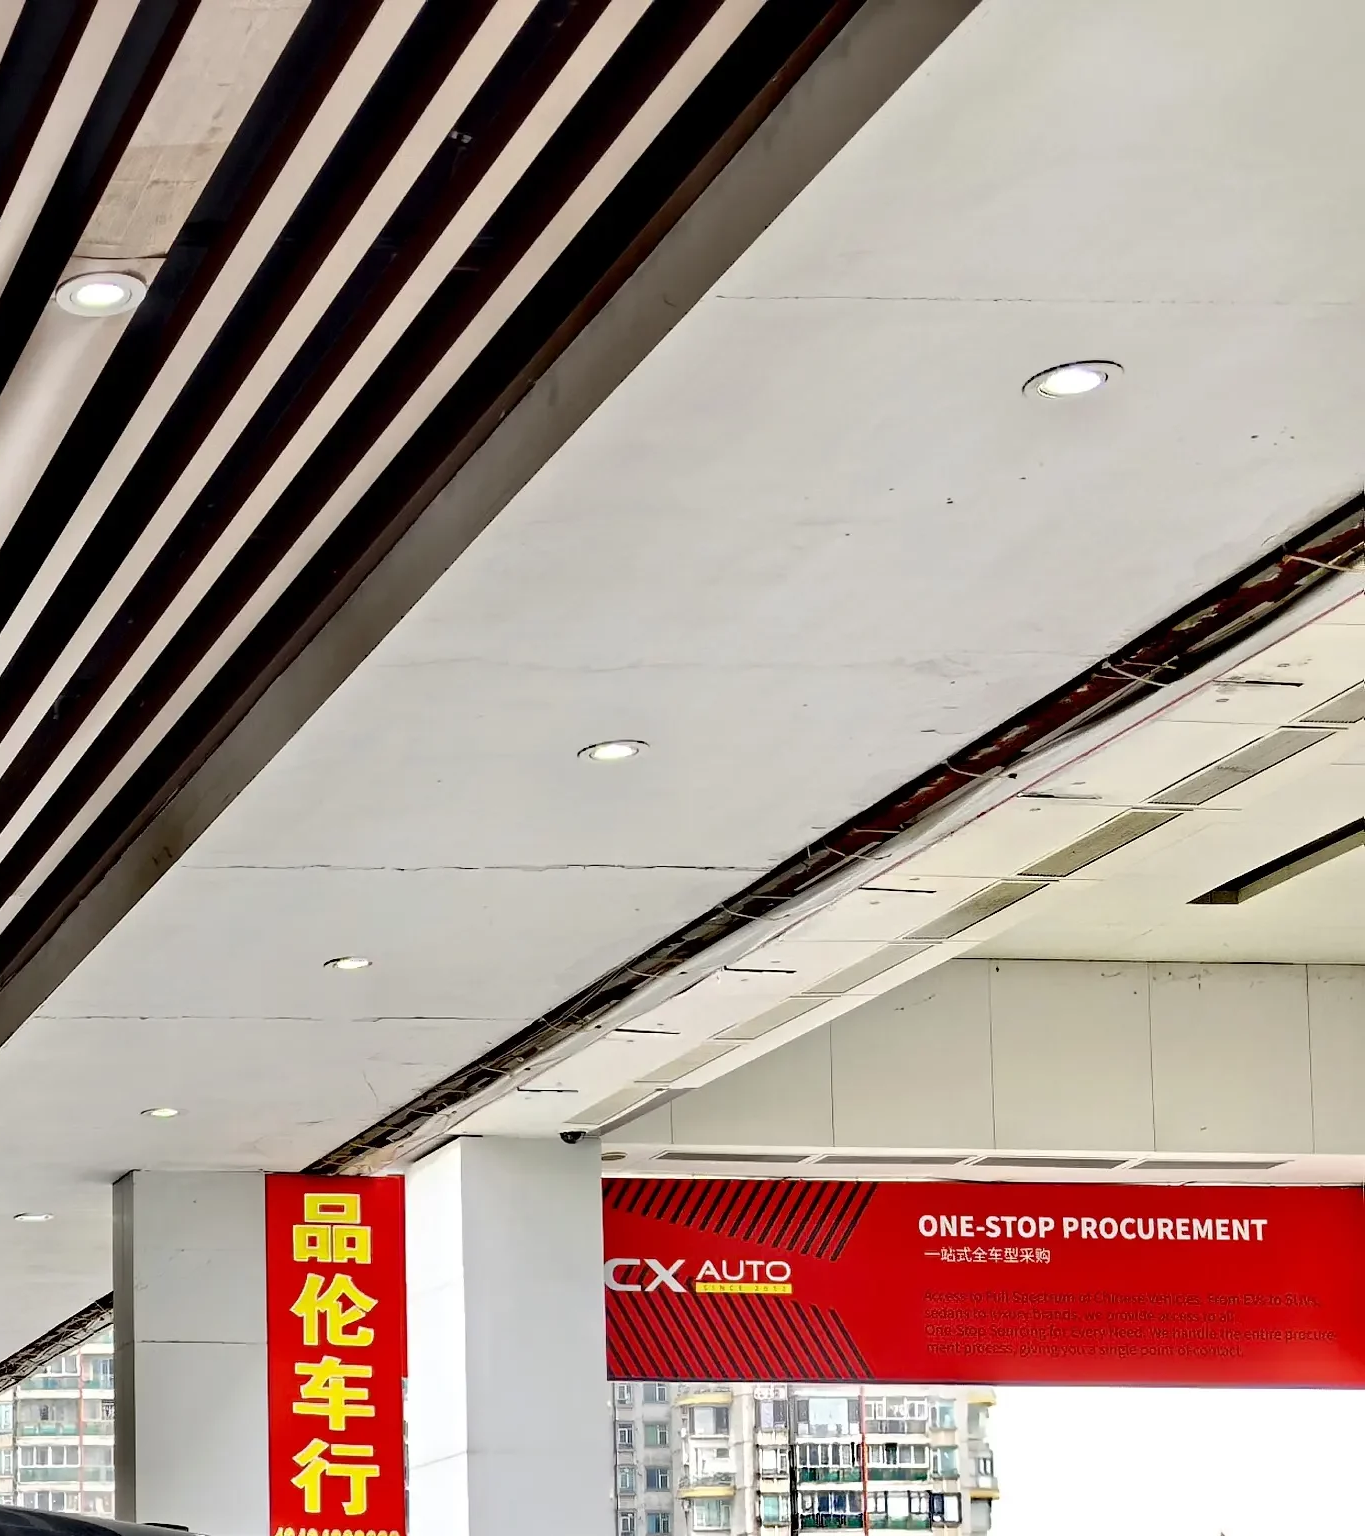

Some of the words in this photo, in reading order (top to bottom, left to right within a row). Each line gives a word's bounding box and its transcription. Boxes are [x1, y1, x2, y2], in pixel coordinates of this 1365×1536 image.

[918, 1214, 1055, 1239] ONE-STOP
[1062, 1216, 1269, 1241] PROCUREMENT
[924, 1246, 1051, 1264] 一站式全车型采购
[604, 1257, 687, 1293] CX
[695, 1259, 792, 1282] AUTO
[291, 1192, 380, 1516] 品伦车行
